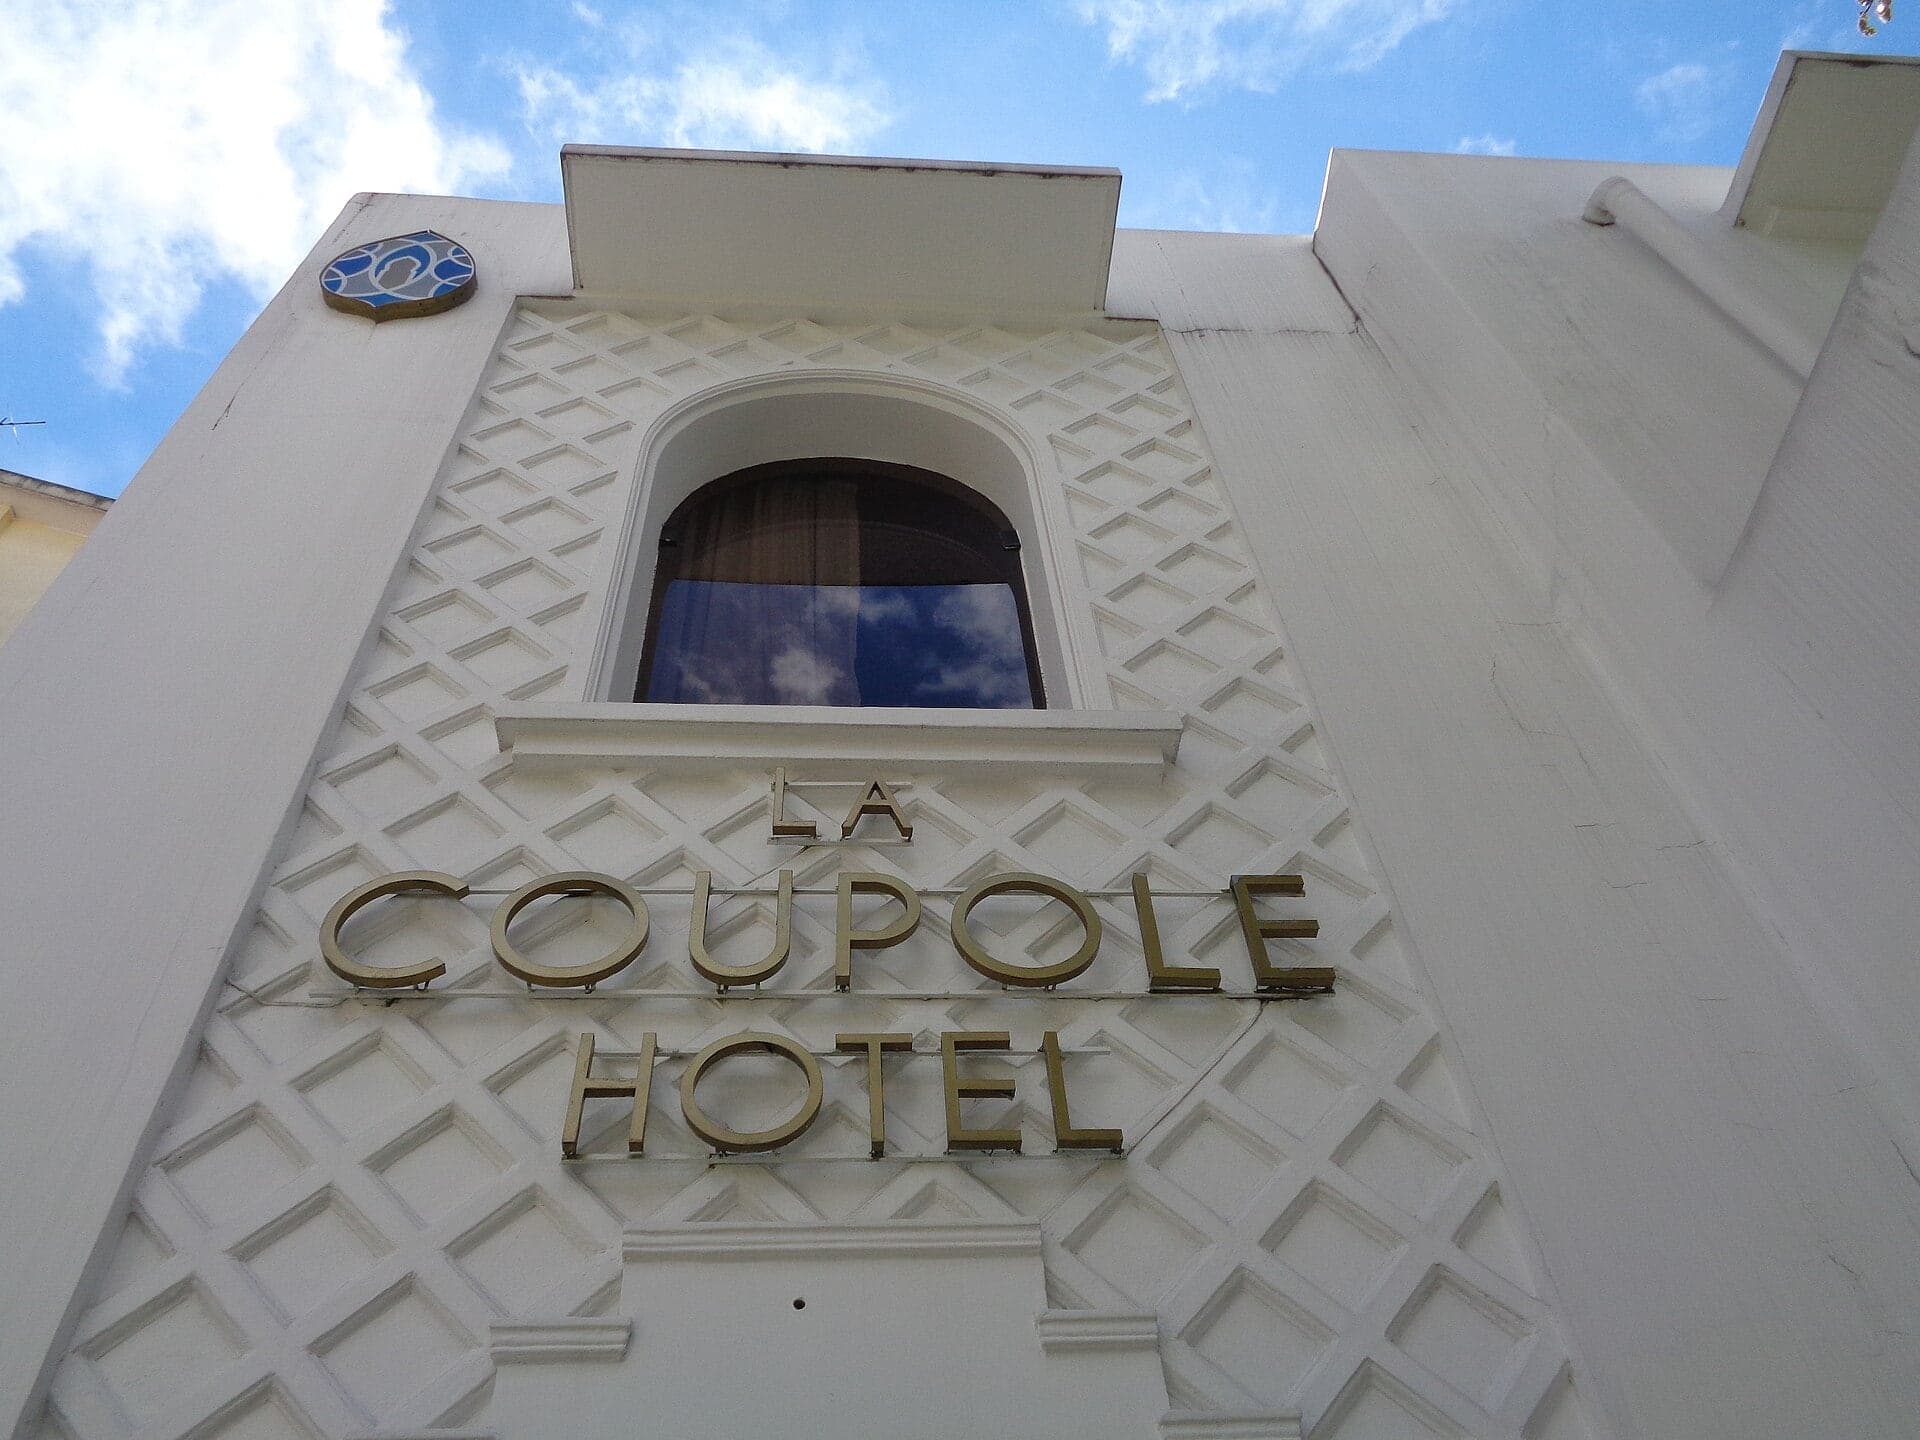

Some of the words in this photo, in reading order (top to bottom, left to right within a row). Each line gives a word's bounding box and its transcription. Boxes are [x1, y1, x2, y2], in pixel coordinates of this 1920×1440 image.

[772, 766, 913, 839] LA
[319, 869, 1336, 991] COUPOLE
[562, 1030, 1123, 1154] HOTEL
